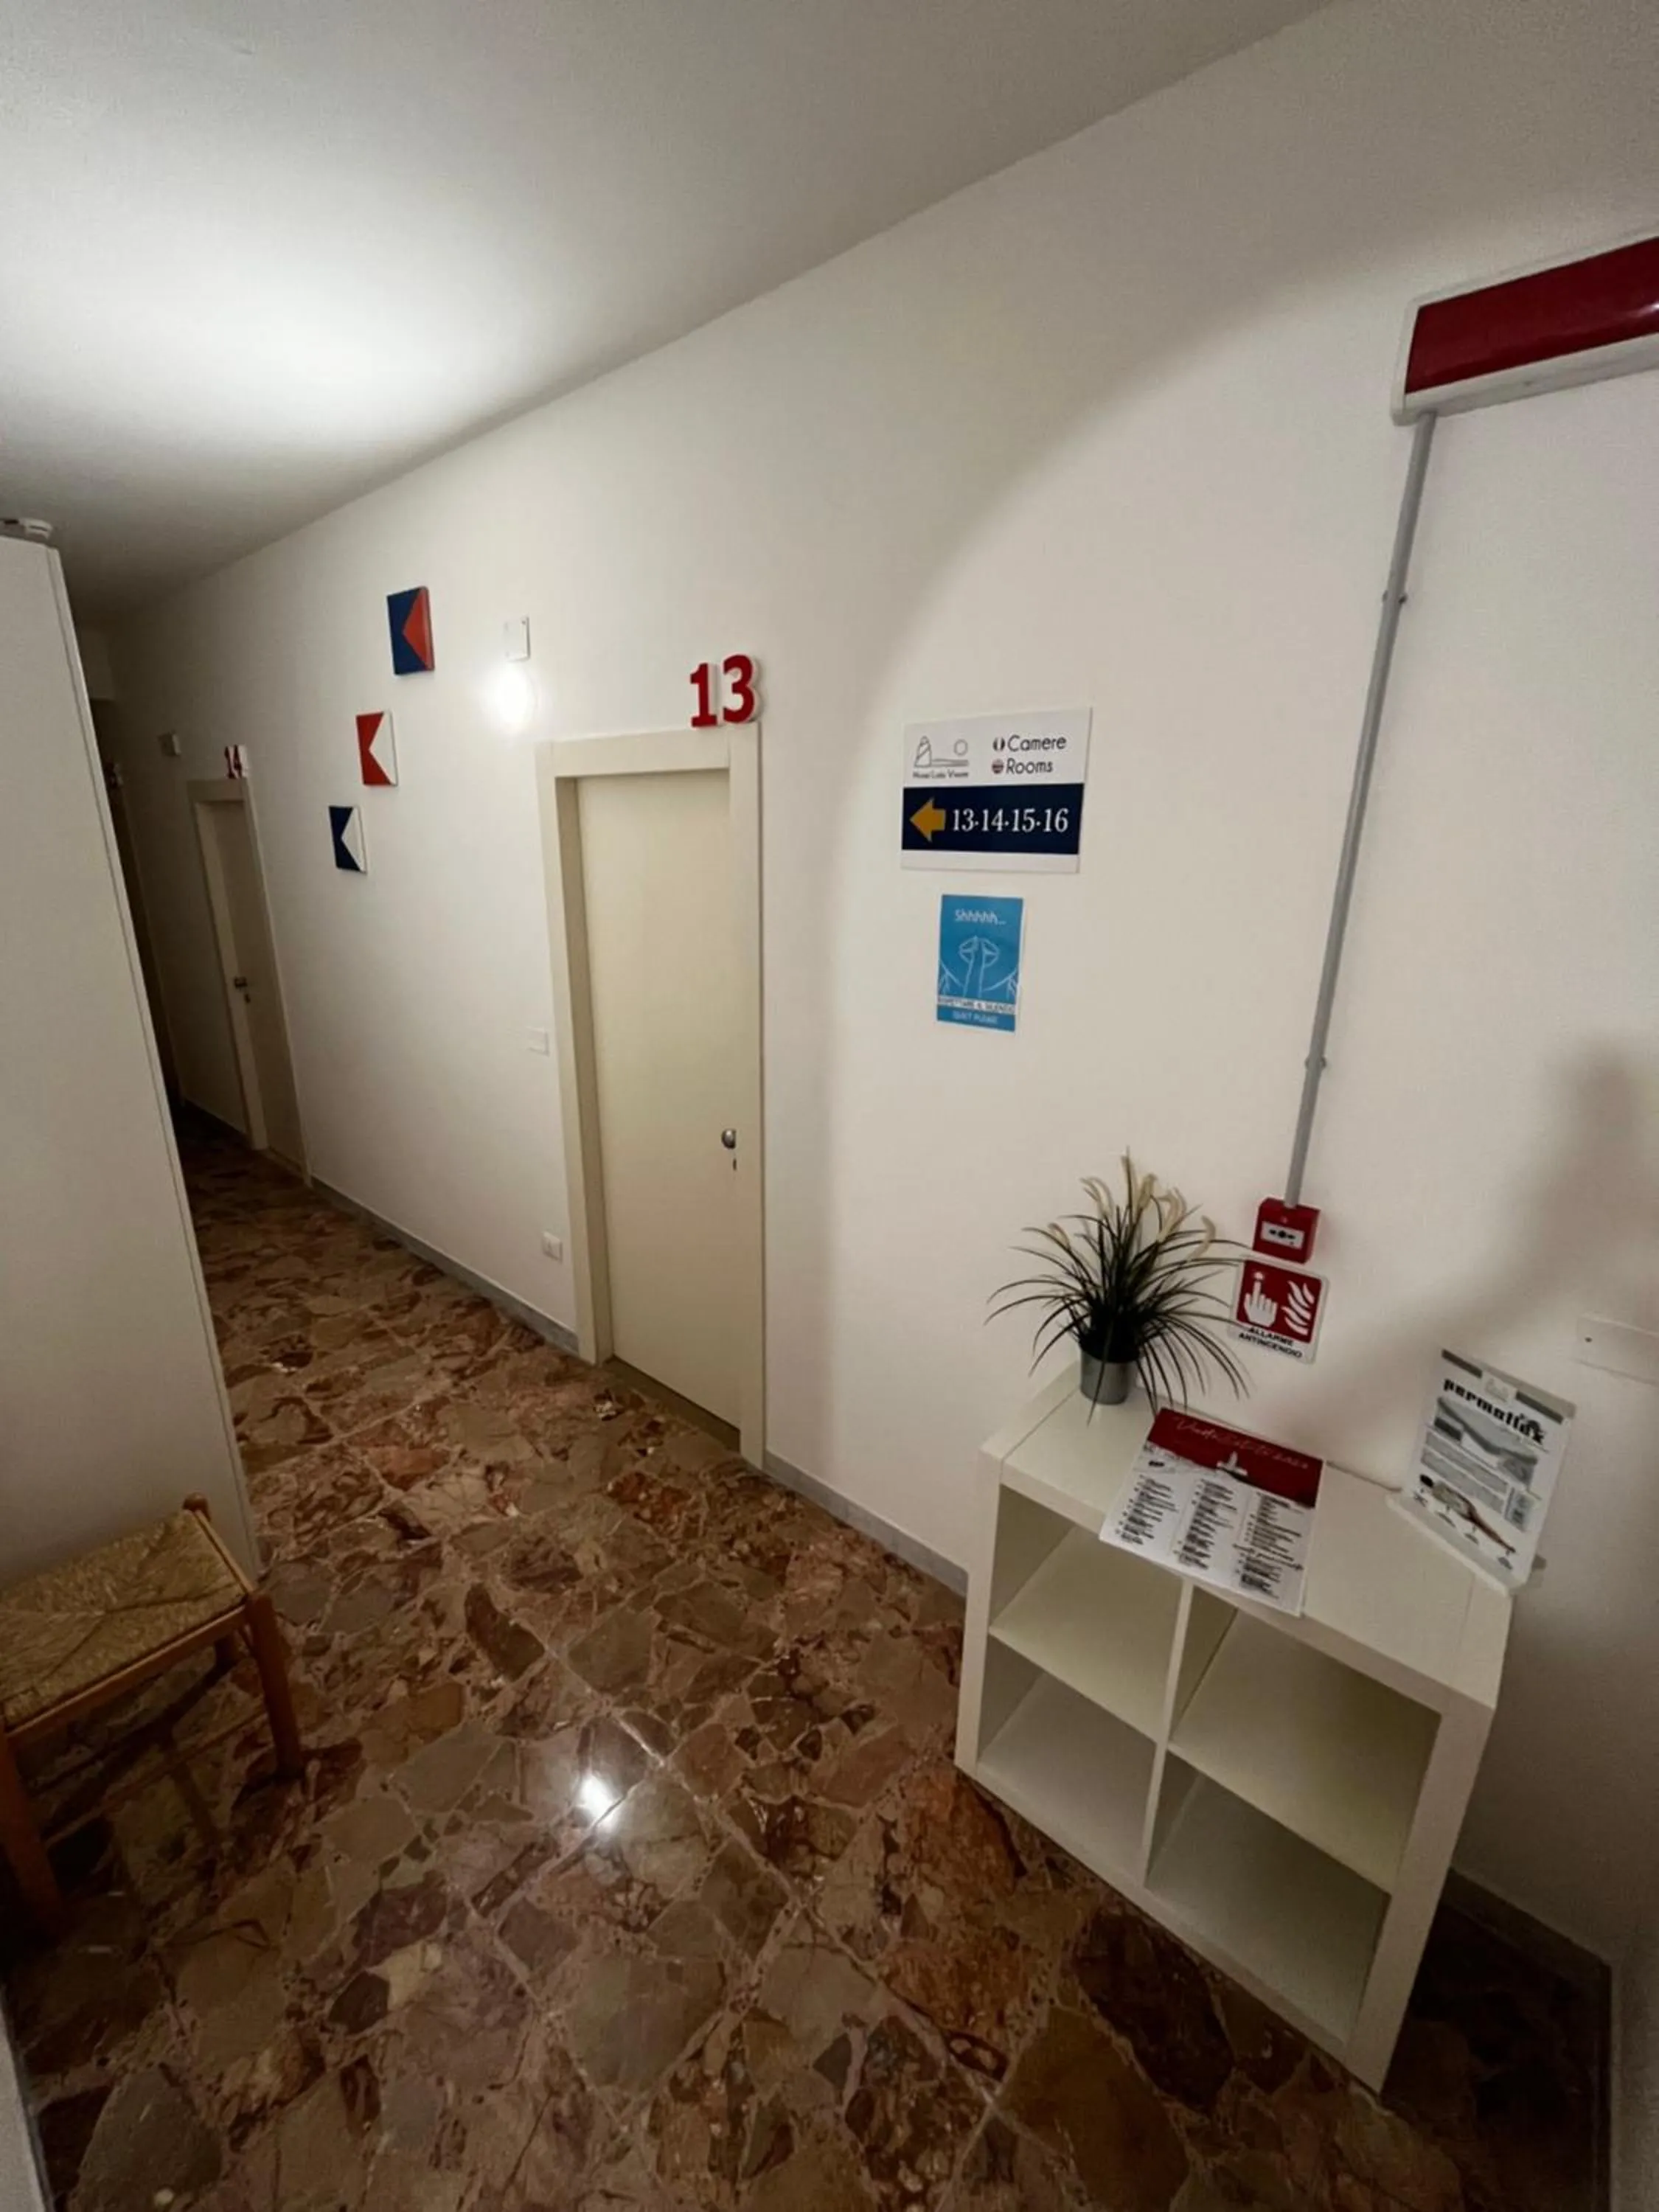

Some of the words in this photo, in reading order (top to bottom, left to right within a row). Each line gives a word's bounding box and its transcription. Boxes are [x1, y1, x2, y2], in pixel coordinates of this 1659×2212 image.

[689, 653, 758, 728] 13
[1007, 734, 1067, 752] Camere
[1006, 757, 1054, 774] Rooms
